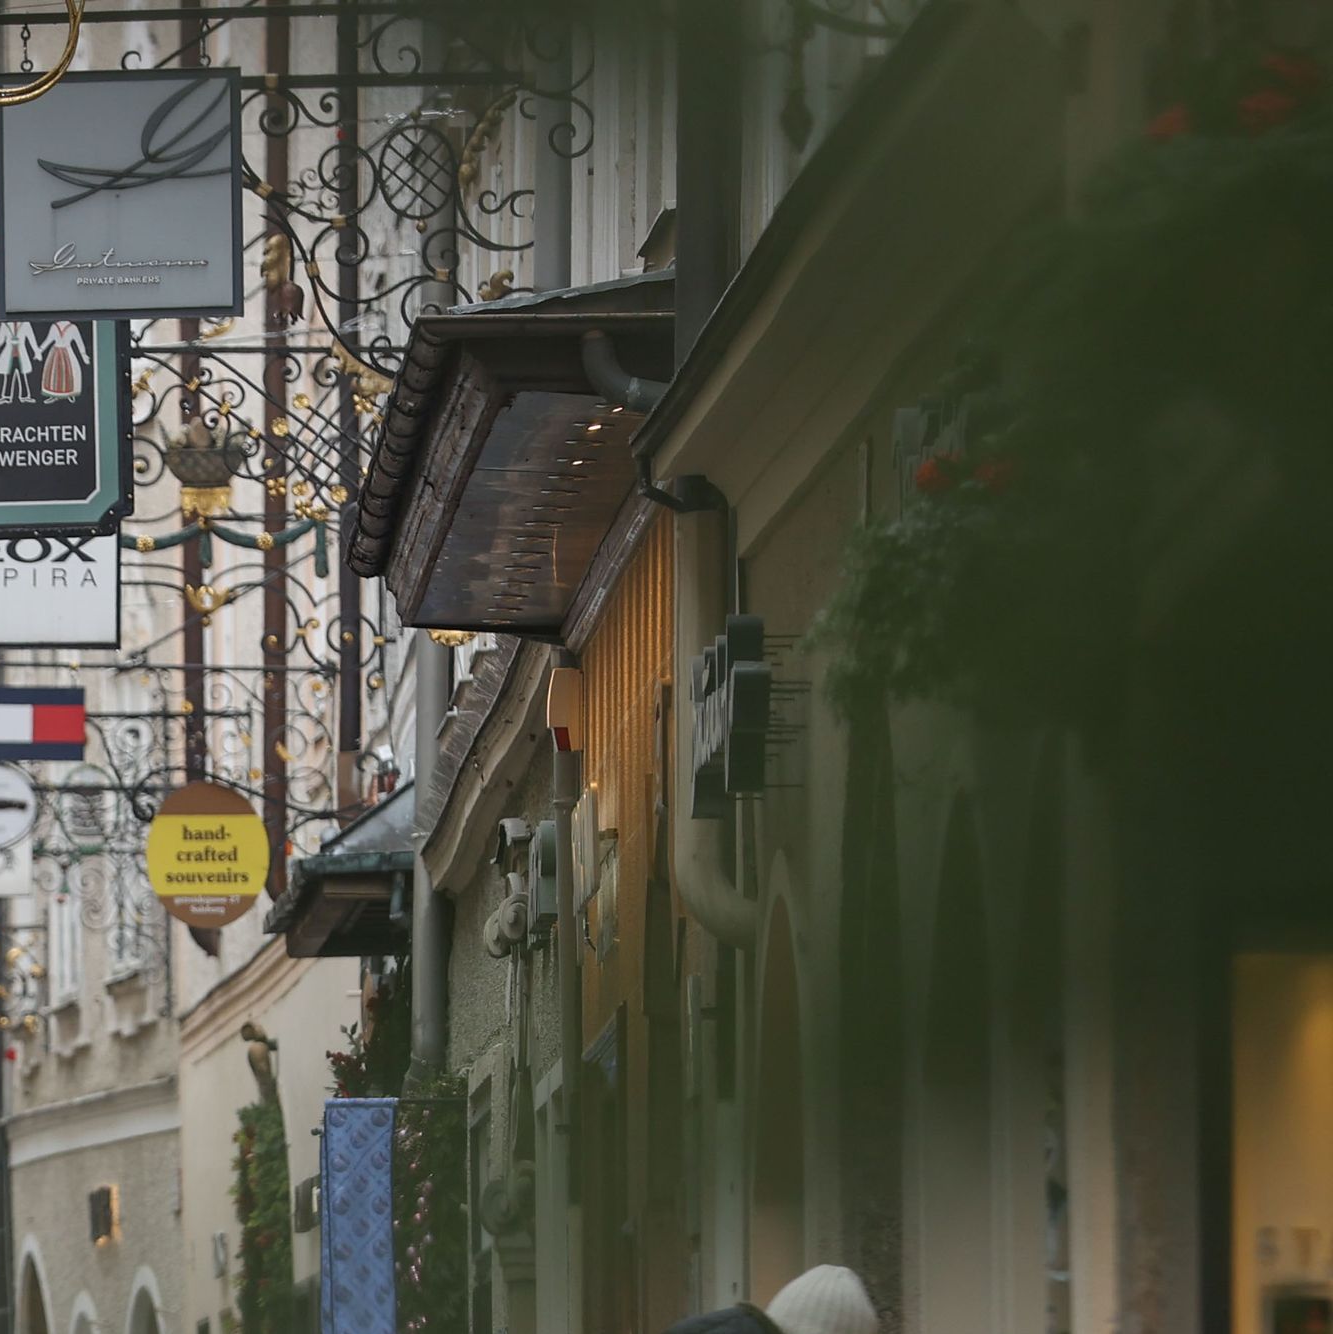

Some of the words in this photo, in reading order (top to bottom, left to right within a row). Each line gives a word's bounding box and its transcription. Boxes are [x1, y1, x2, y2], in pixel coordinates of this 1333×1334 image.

[77, 277, 114, 286] PRIVATE
[117, 275, 161, 285] BANKERS
[182, 824, 231, 841] hand-
[176, 846, 239, 862] crafted
[165, 867, 250, 884] souvenirs
